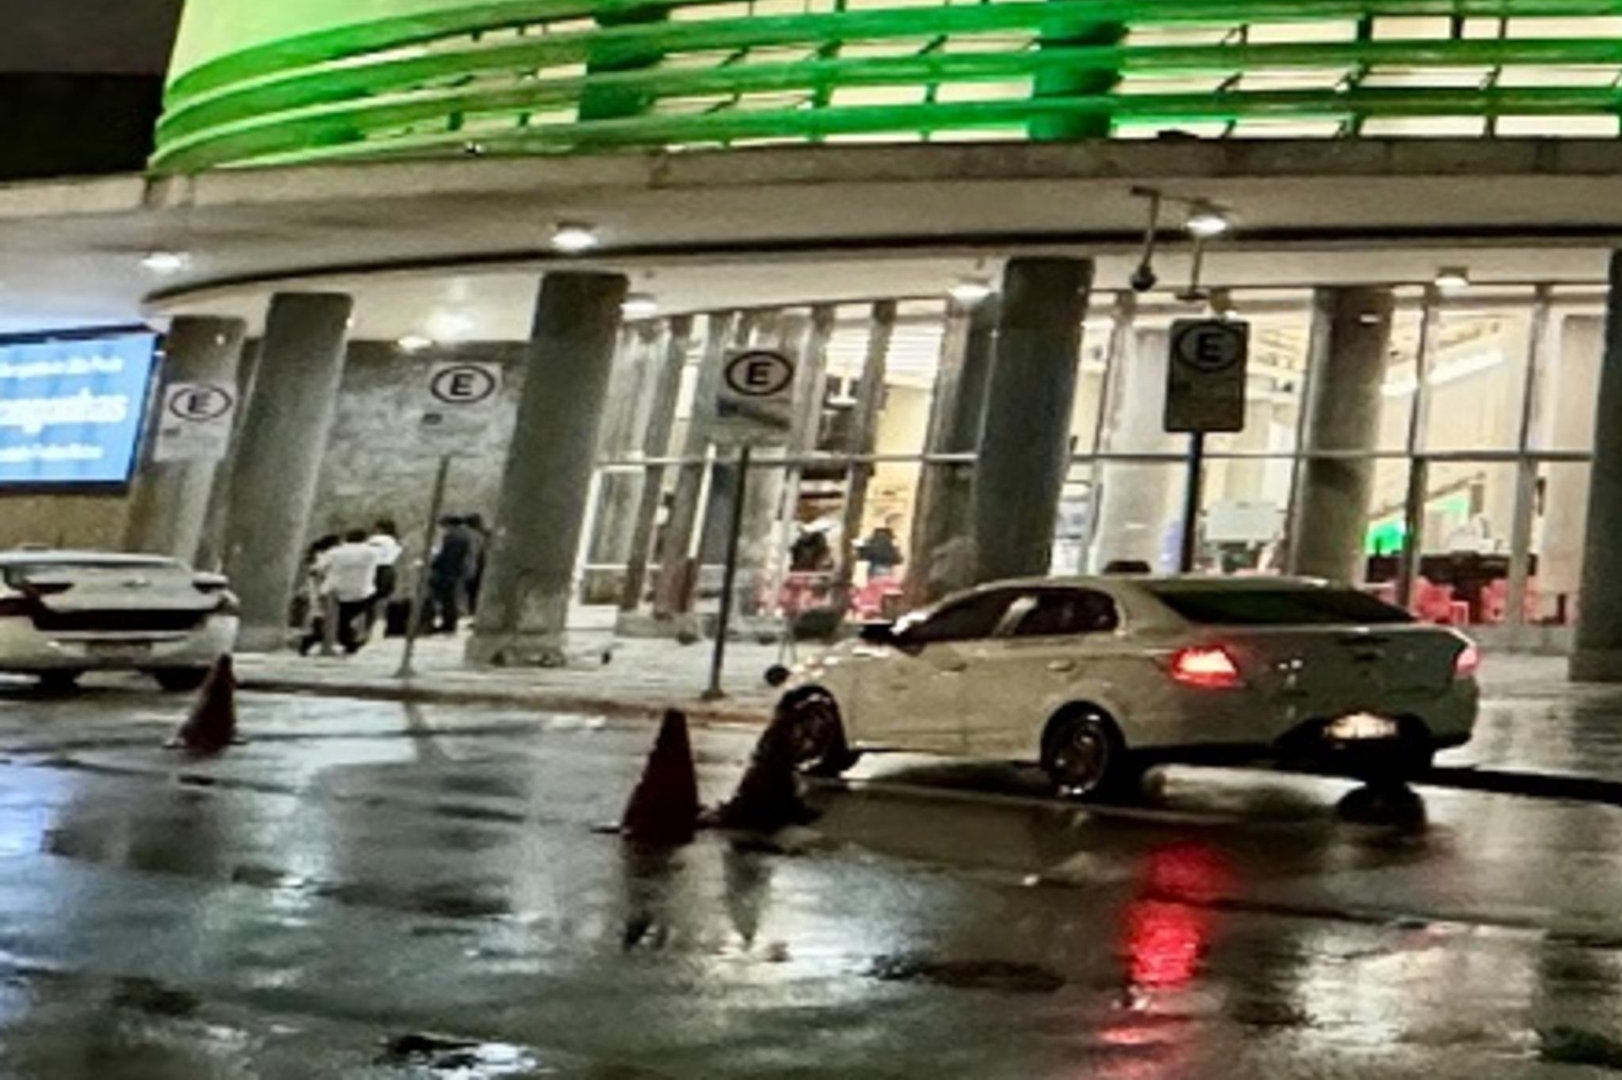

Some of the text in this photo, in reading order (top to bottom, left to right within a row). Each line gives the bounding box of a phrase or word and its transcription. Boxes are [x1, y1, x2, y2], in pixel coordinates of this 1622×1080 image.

[1196, 332, 1226, 363] E
[450, 373, 474, 396] E
[746, 362, 774, 385] E
[188, 393, 211, 414] E
